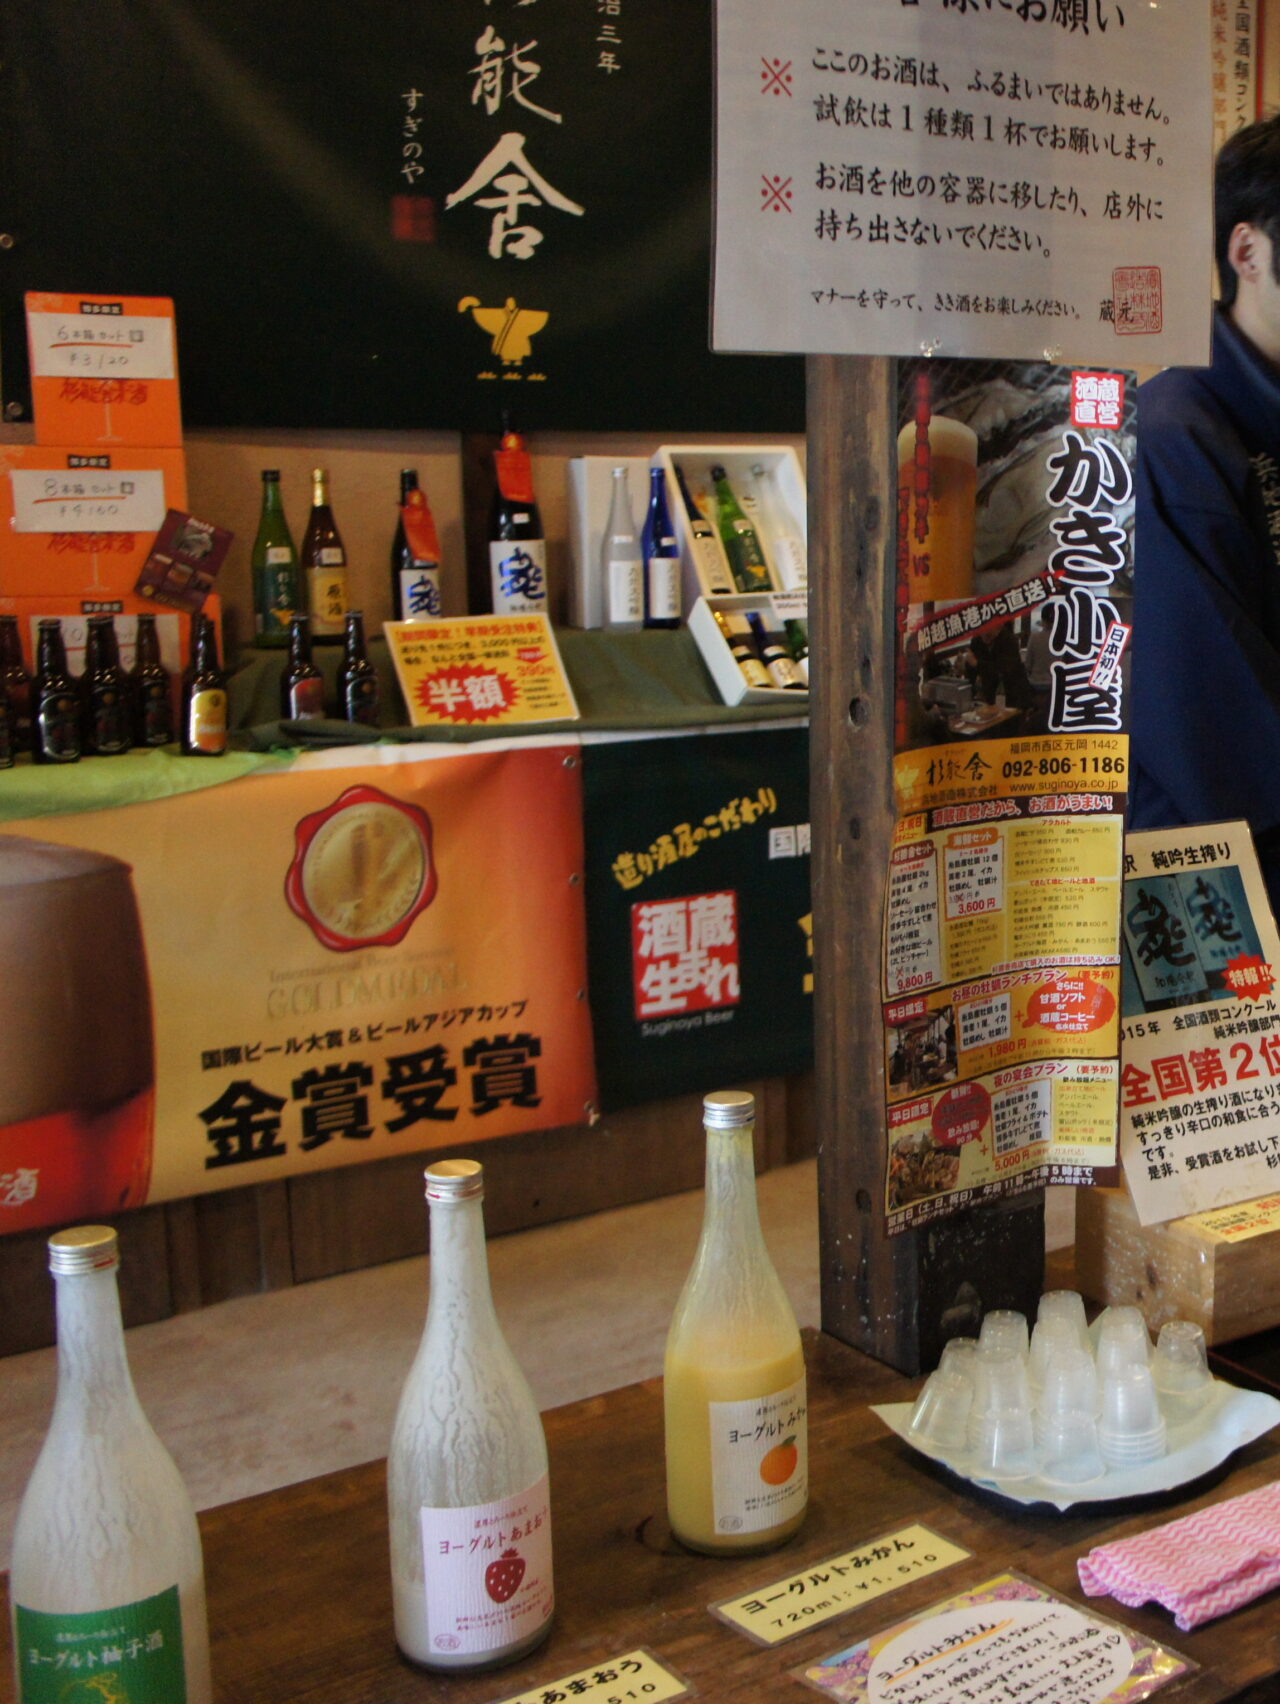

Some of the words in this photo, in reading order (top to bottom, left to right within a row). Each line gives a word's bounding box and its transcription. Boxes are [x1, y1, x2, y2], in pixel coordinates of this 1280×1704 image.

[400, 87, 426, 185] すぎのや
[445, 0, 586, 260] 能舎
[814, 161, 1165, 221] お酒を他の容器に移したり、店外に
[814, 208, 1052, 258] 持ち出さないでください。
[1074, 376, 1120, 400] 酒蔵
[1074, 401, 1120, 424] 直営
[1047, 431, 1133, 732] かき小屋
[428, 674, 507, 713] 半額
[1002, 756, 1126, 779] 092-806-1186
[1092, 739, 1119, 751] 1442
[1009, 778, 1119, 793] www.suginoya.co.jp
[1151, 840, 1232, 871] 純吟生搾り
[638, 893, 736, 959] 酒蔵
[639, 949, 741, 1016] 生まれ
[641, 1016, 703, 1038] Suginoya
[704, 1009, 735, 1026] Beer
[198, 1032, 544, 1171] 金賞受賞
[740, 1537, 916, 1616] ヨーグルトみかん
[513, 1658, 644, 1704] あまおう
